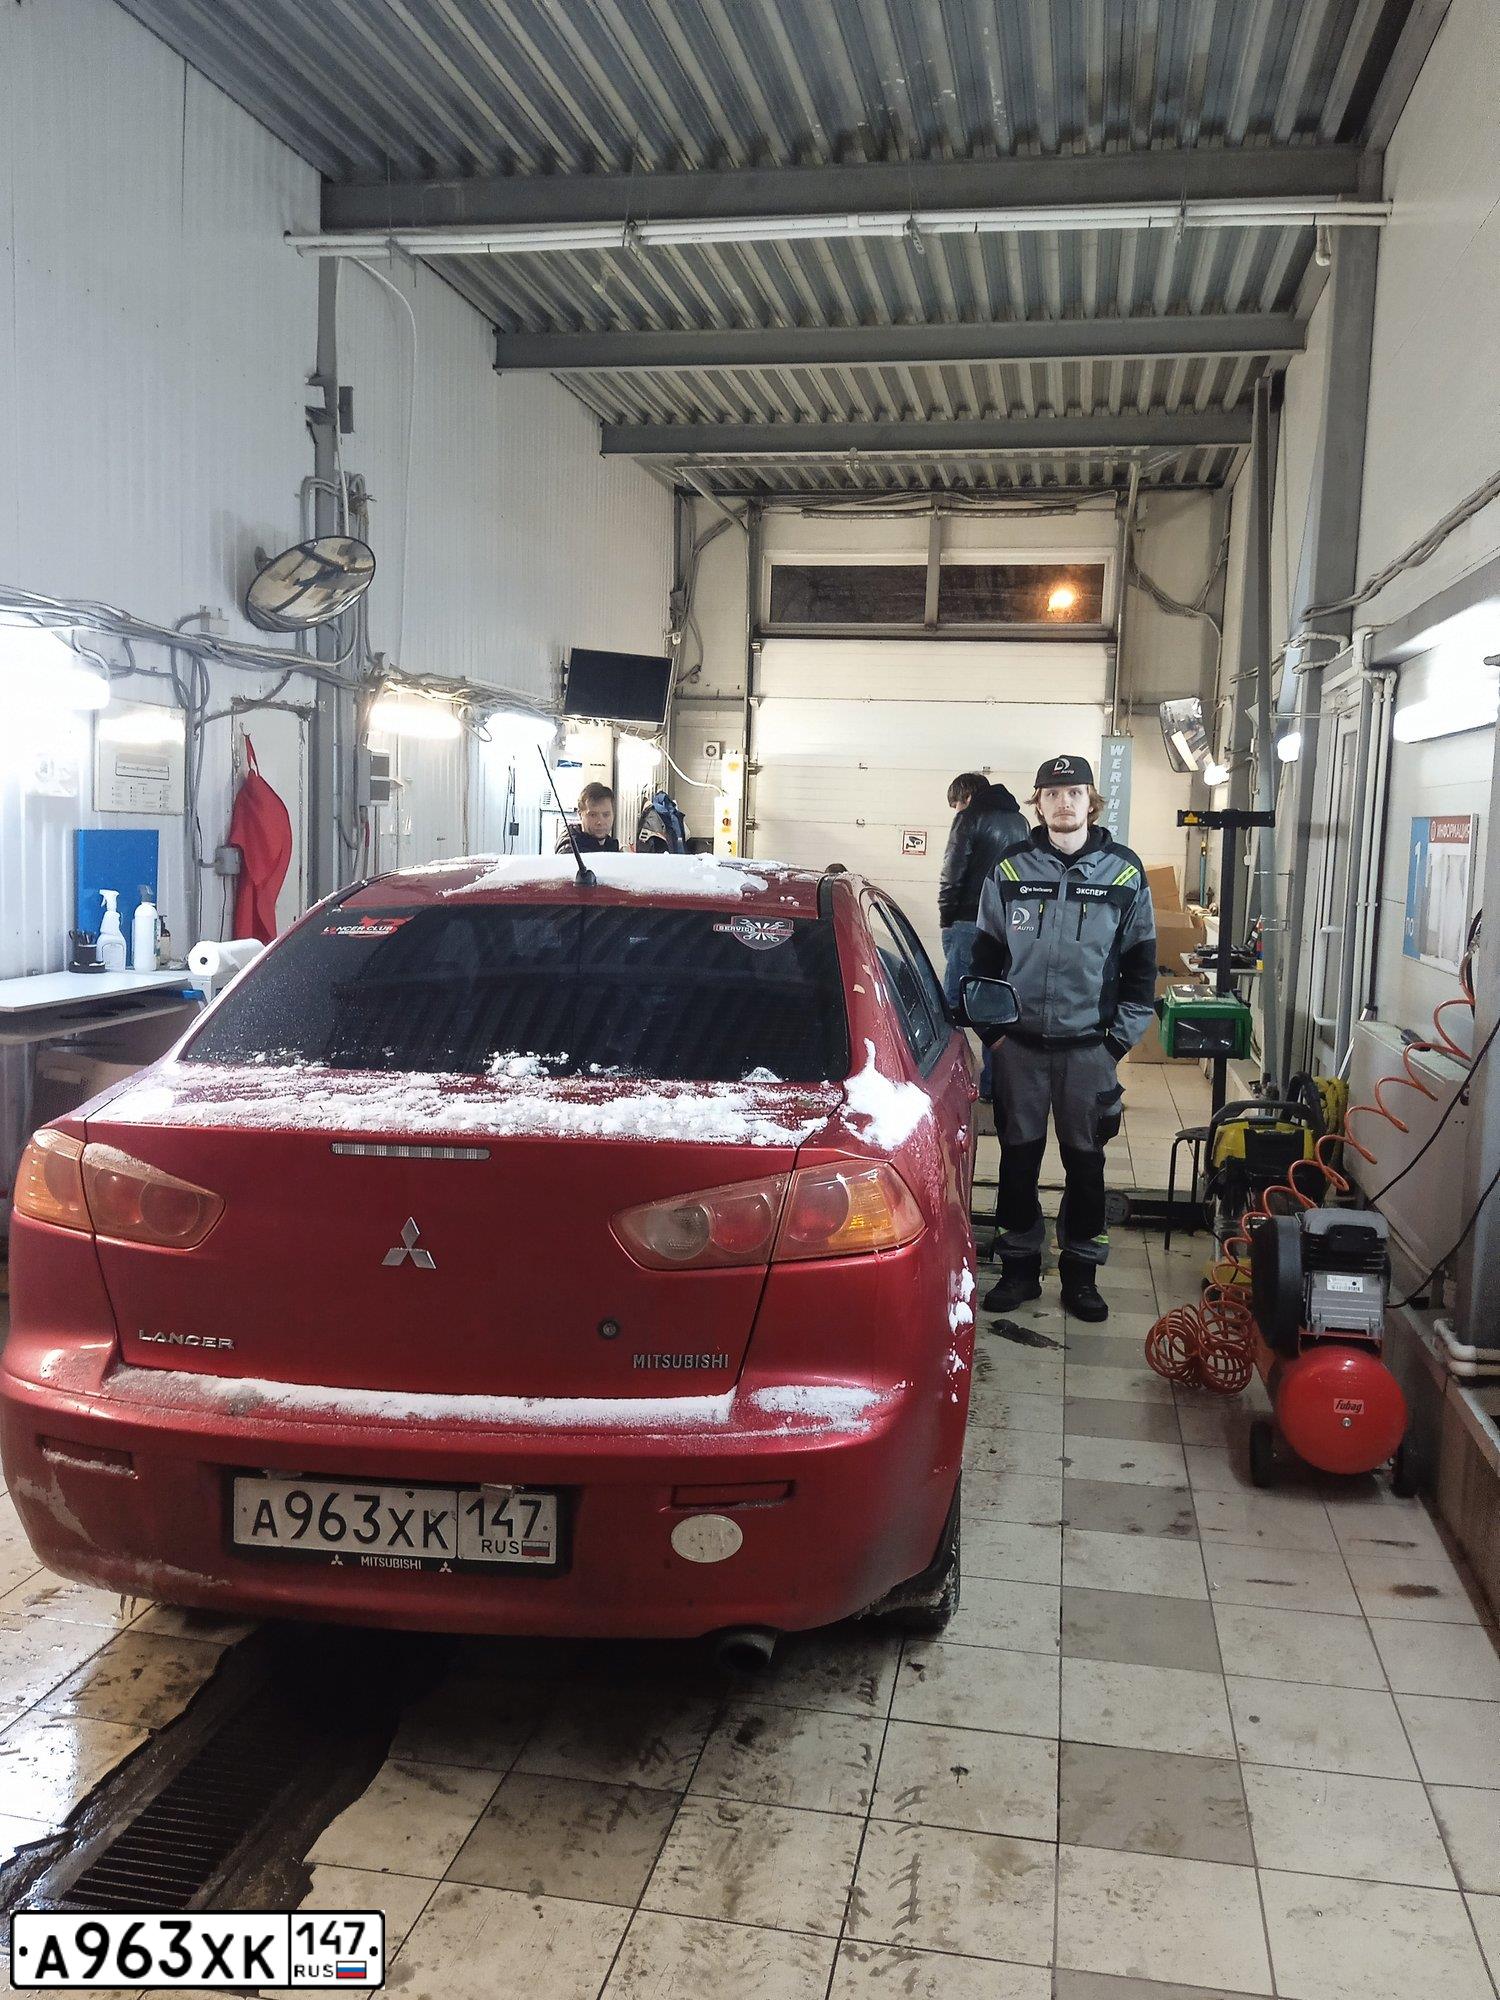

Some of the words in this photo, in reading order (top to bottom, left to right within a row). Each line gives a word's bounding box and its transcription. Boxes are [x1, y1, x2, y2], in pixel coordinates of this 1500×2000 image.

[1107, 744, 1125, 837] WERTHER
[1076, 887, 1108, 897] ЭКСПЕРТ
[138, 1329, 235, 1350] LANCER
[633, 1354, 729, 1369] MITSUBISHI
[1335, 1400, 1363, 1413] fubag
[465, 1496, 542, 1539] 147
[481, 1539, 520, 1555] RUS
[361, 1555, 422, 1571] MITSUBISHI
